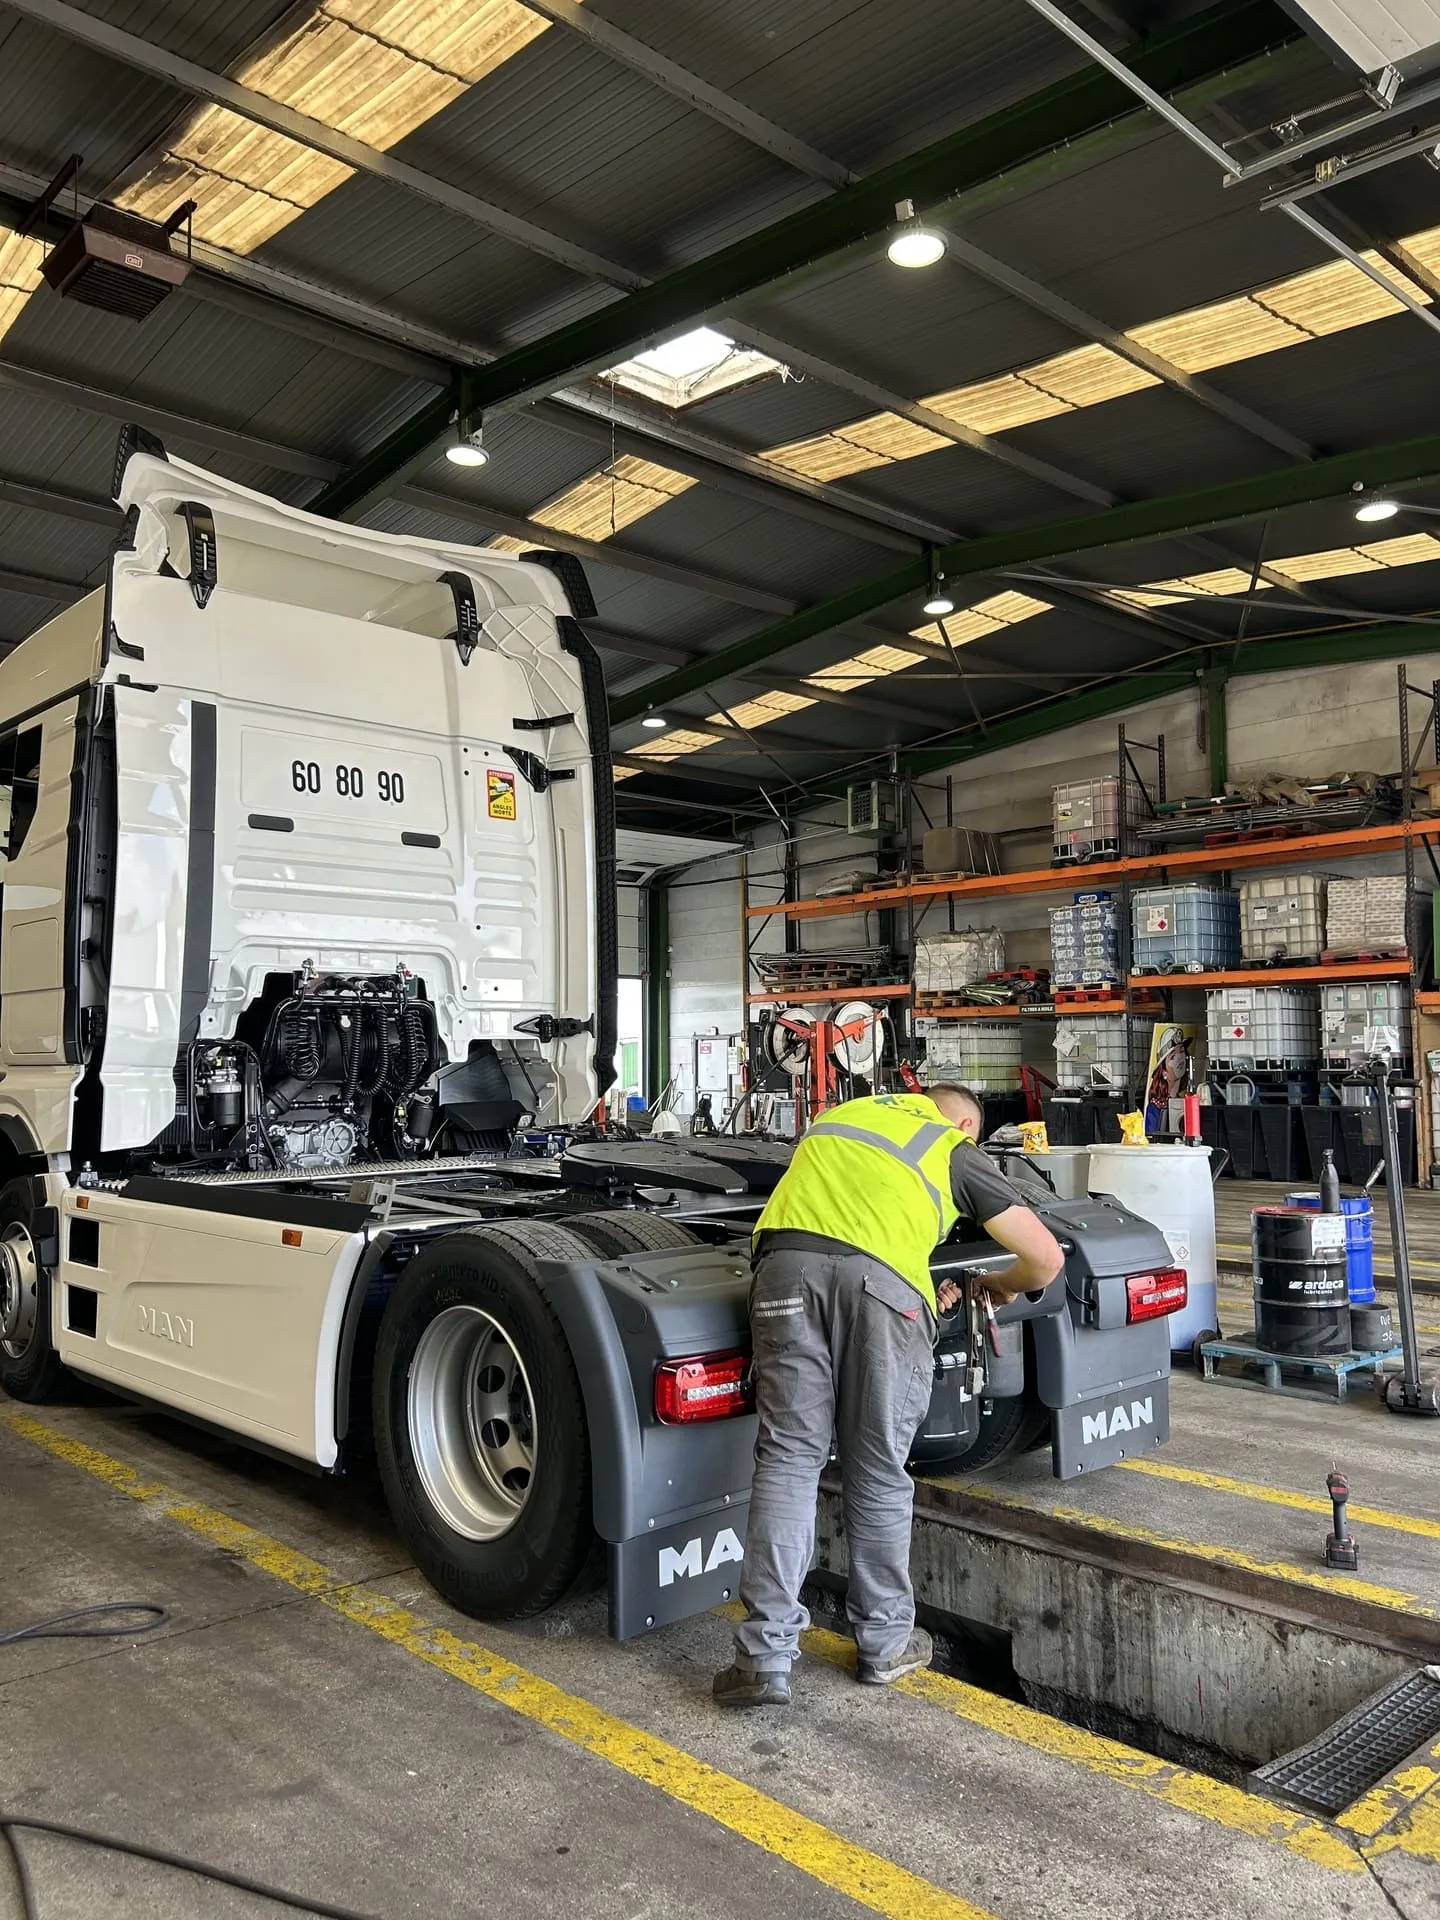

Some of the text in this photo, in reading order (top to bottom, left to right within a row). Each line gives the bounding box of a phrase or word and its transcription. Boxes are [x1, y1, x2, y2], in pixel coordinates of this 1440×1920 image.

[291, 760, 404, 803] 60 80 90
[1304, 1274, 1344, 1290] ardeca
[138, 1304, 194, 1348] MAN
[1081, 1396, 1153, 1445] MAN
[658, 1527, 745, 1588] MA
